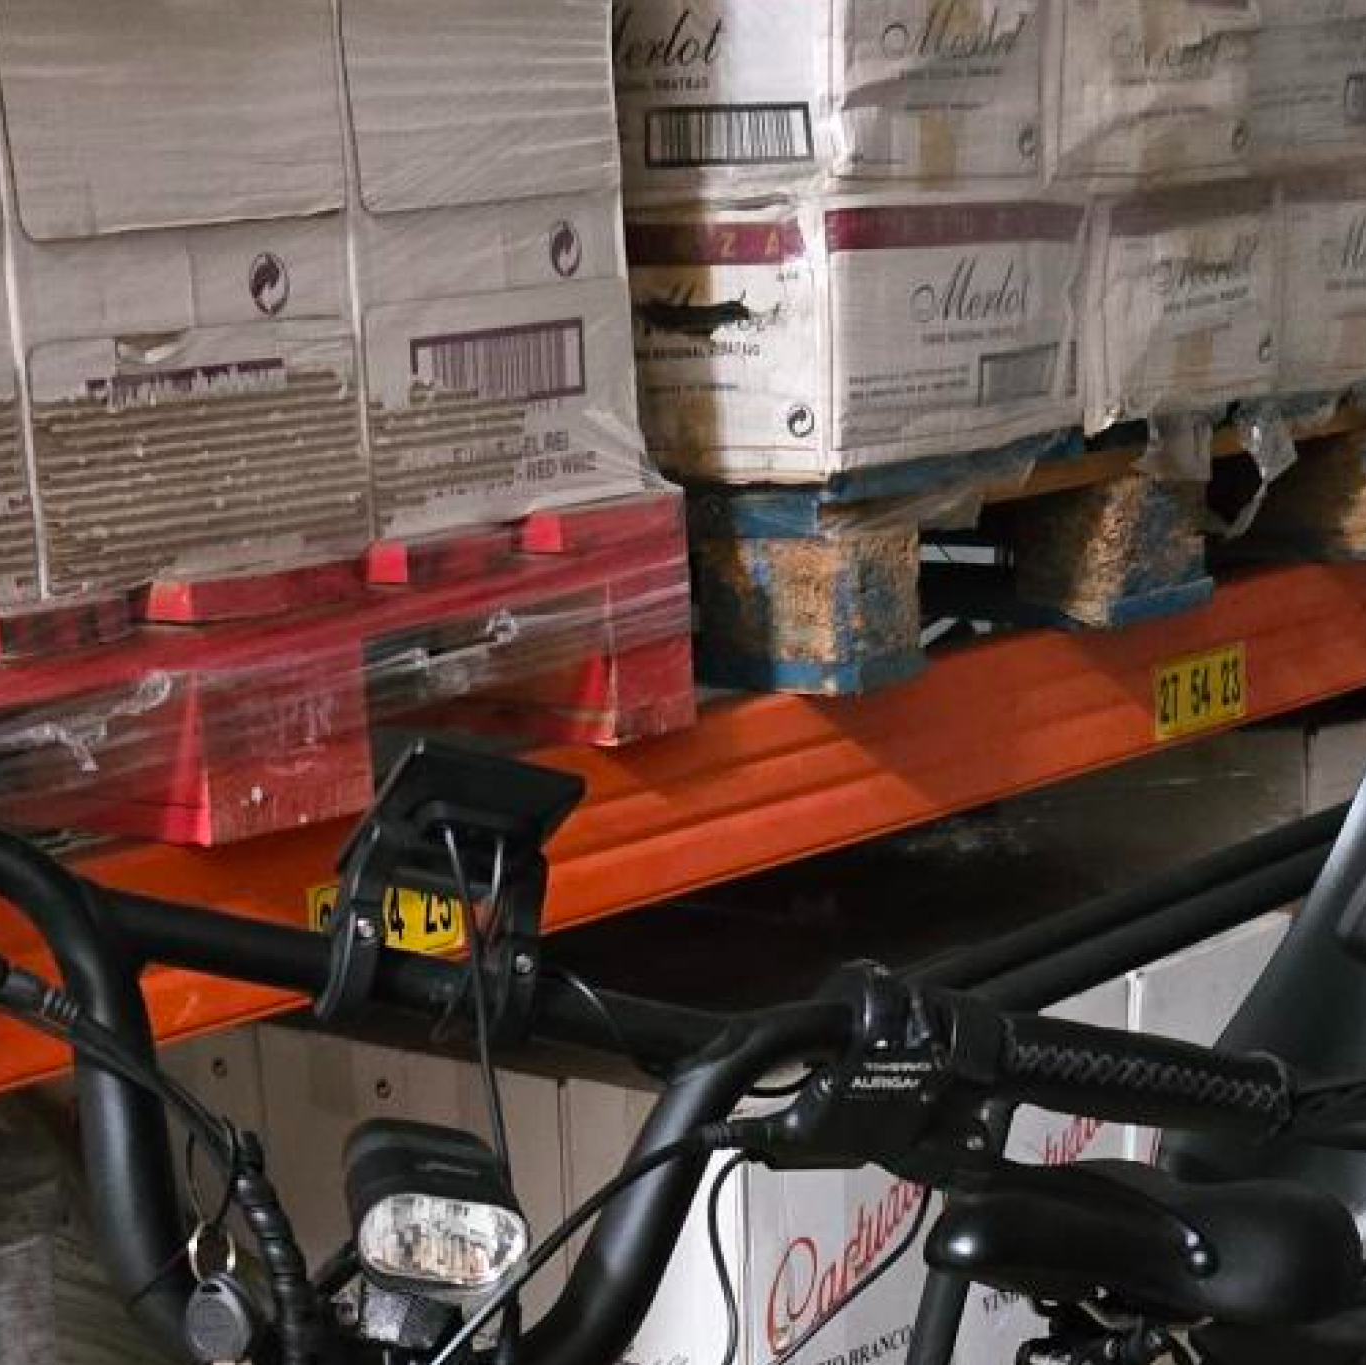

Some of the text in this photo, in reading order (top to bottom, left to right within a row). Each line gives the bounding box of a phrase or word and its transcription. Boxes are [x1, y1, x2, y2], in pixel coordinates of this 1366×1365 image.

[1159, 656, 1241, 725] 27 54 23
